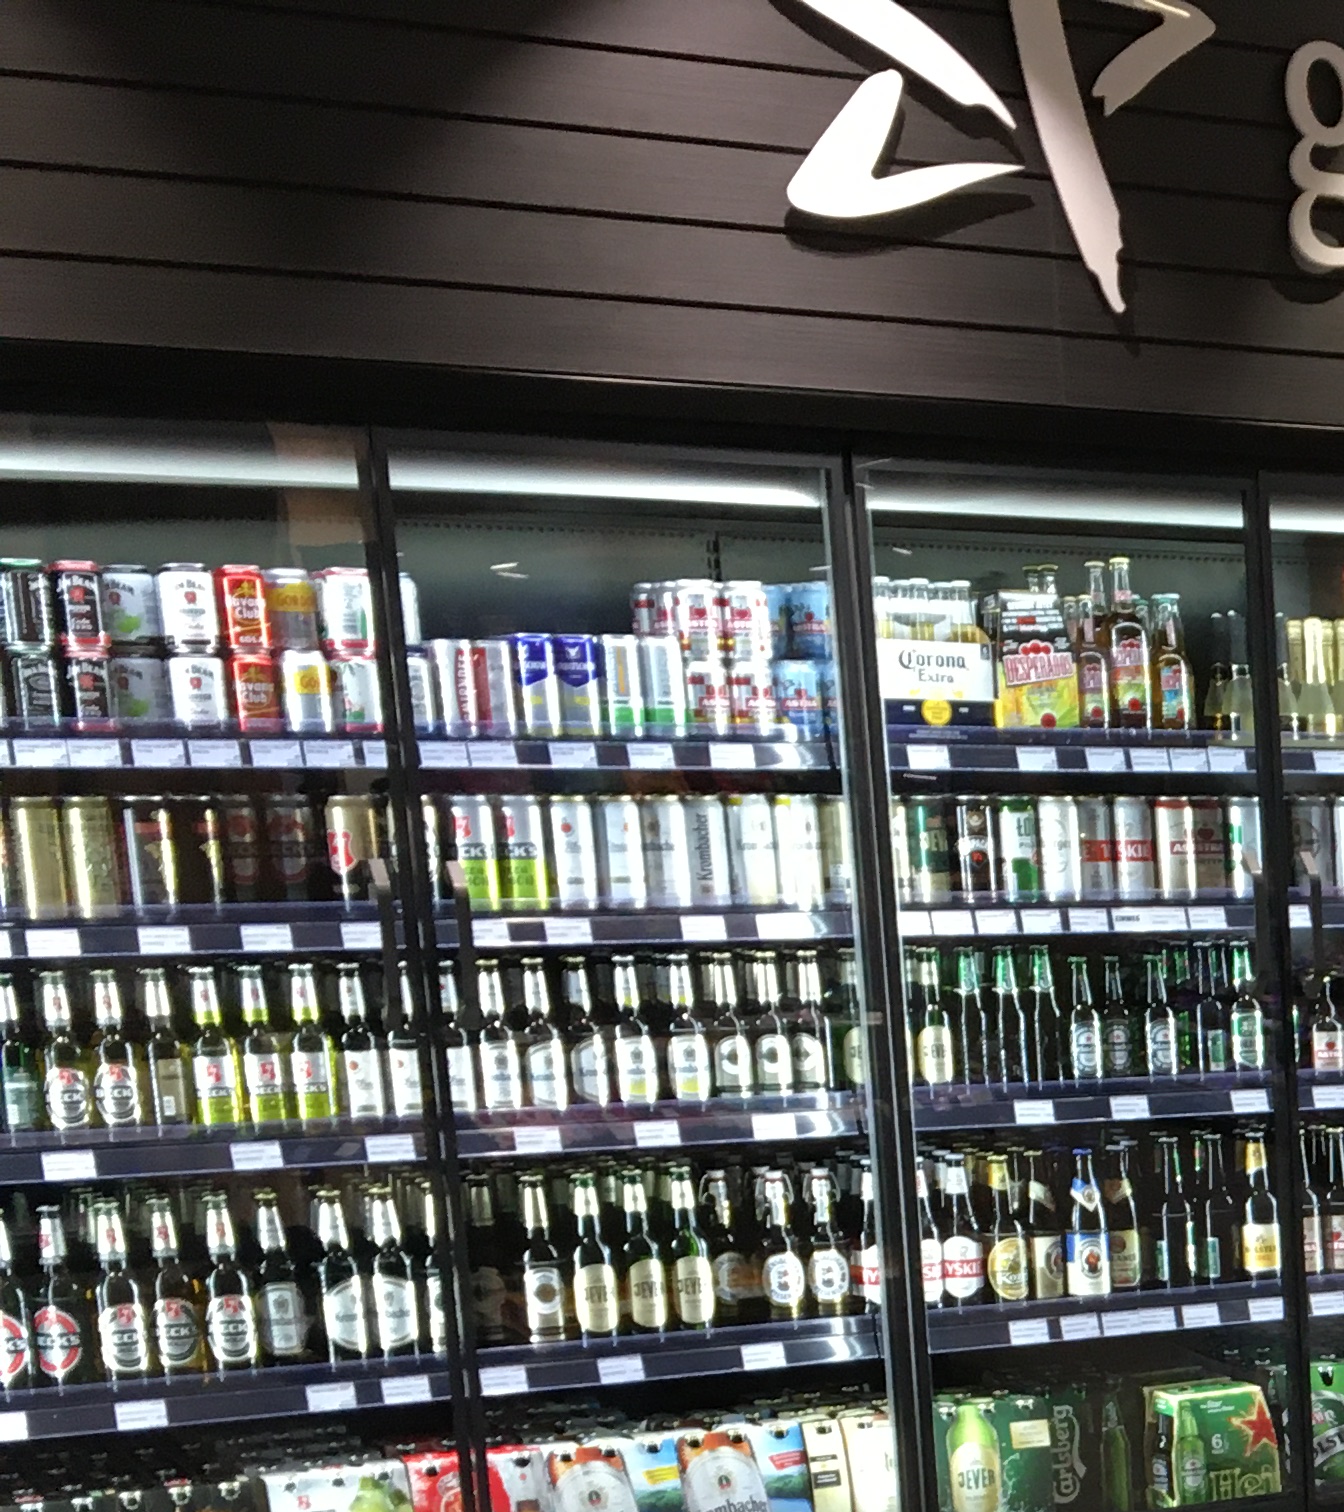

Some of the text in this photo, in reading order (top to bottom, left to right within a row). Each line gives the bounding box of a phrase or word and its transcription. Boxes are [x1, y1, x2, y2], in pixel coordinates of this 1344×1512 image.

[899, 649, 966, 669] Corona
[912, 666, 954, 684] Extra
[1054, 1404, 1087, 1503] Carlsberg
[958, 1467, 995, 1489] JEVER
